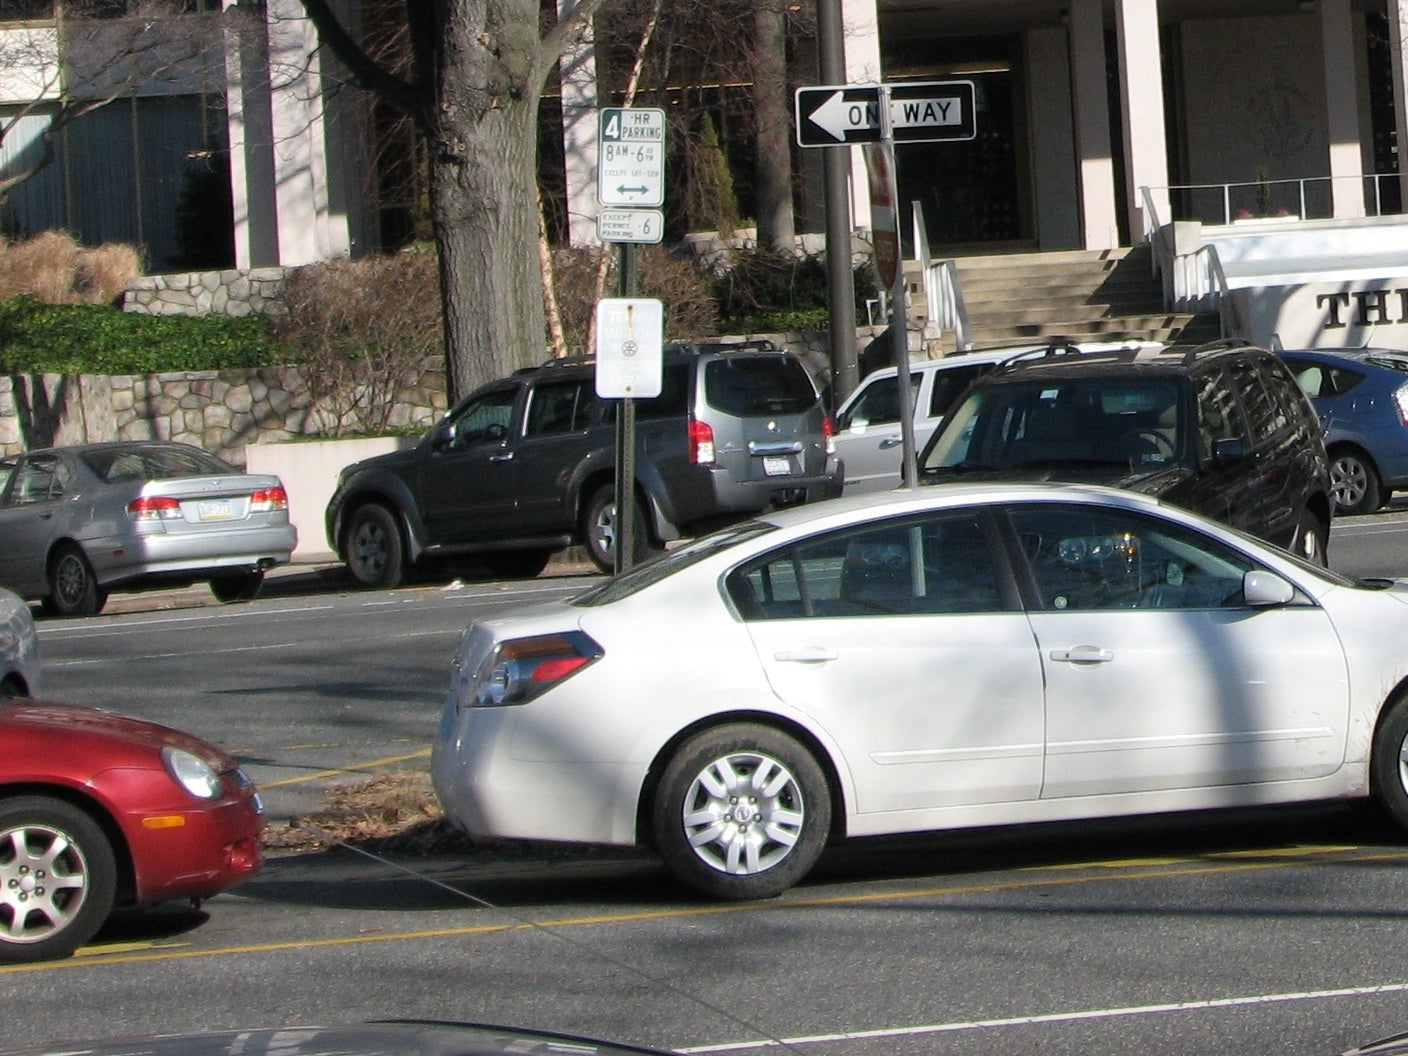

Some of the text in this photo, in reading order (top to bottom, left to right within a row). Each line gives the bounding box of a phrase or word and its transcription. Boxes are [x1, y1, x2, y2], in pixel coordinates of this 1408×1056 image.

[633, 113, 651, 125] HR
[849, 102, 951, 126] ON WAY
[604, 115, 619, 139] 4
[622, 127, 662, 139] PARKING
[642, 218, 651, 235] 6
[601, 230, 633, 239] PARKING
